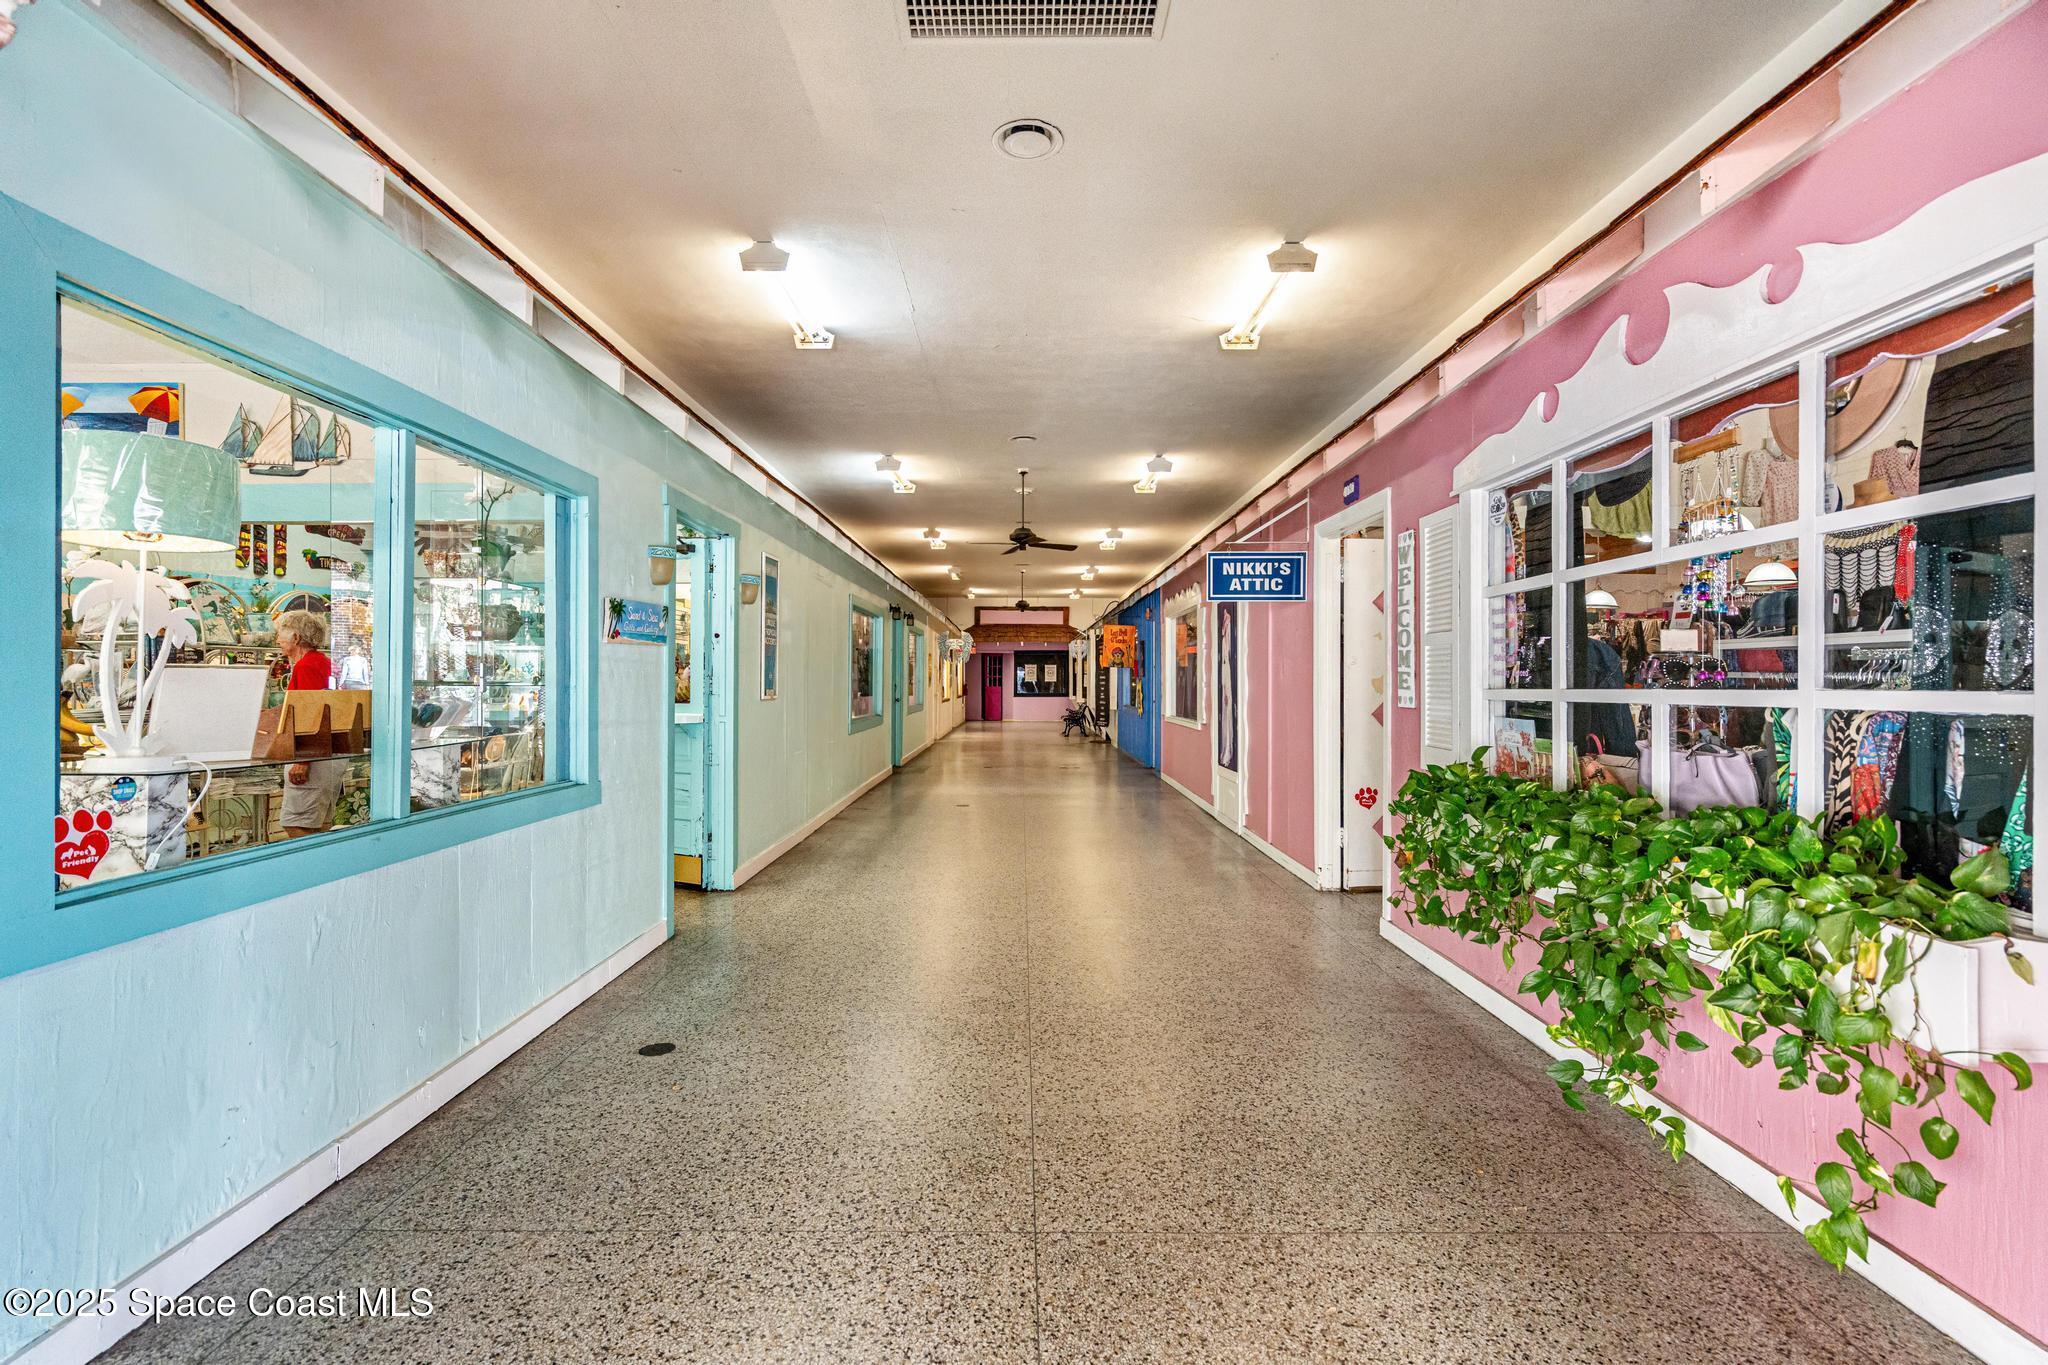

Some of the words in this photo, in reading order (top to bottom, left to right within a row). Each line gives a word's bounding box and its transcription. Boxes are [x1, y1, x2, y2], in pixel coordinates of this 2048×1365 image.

[1222, 562, 1291, 576] NIKKI'S
[1229, 578, 1284, 591] ATTIC
[627, 606, 642, 620] Sand
[648, 608, 659, 622] Sea
[1398, 544, 1412, 691] WELCOME
[73, 849, 89, 857] Pet
[61, 856, 100, 868] Friendly
